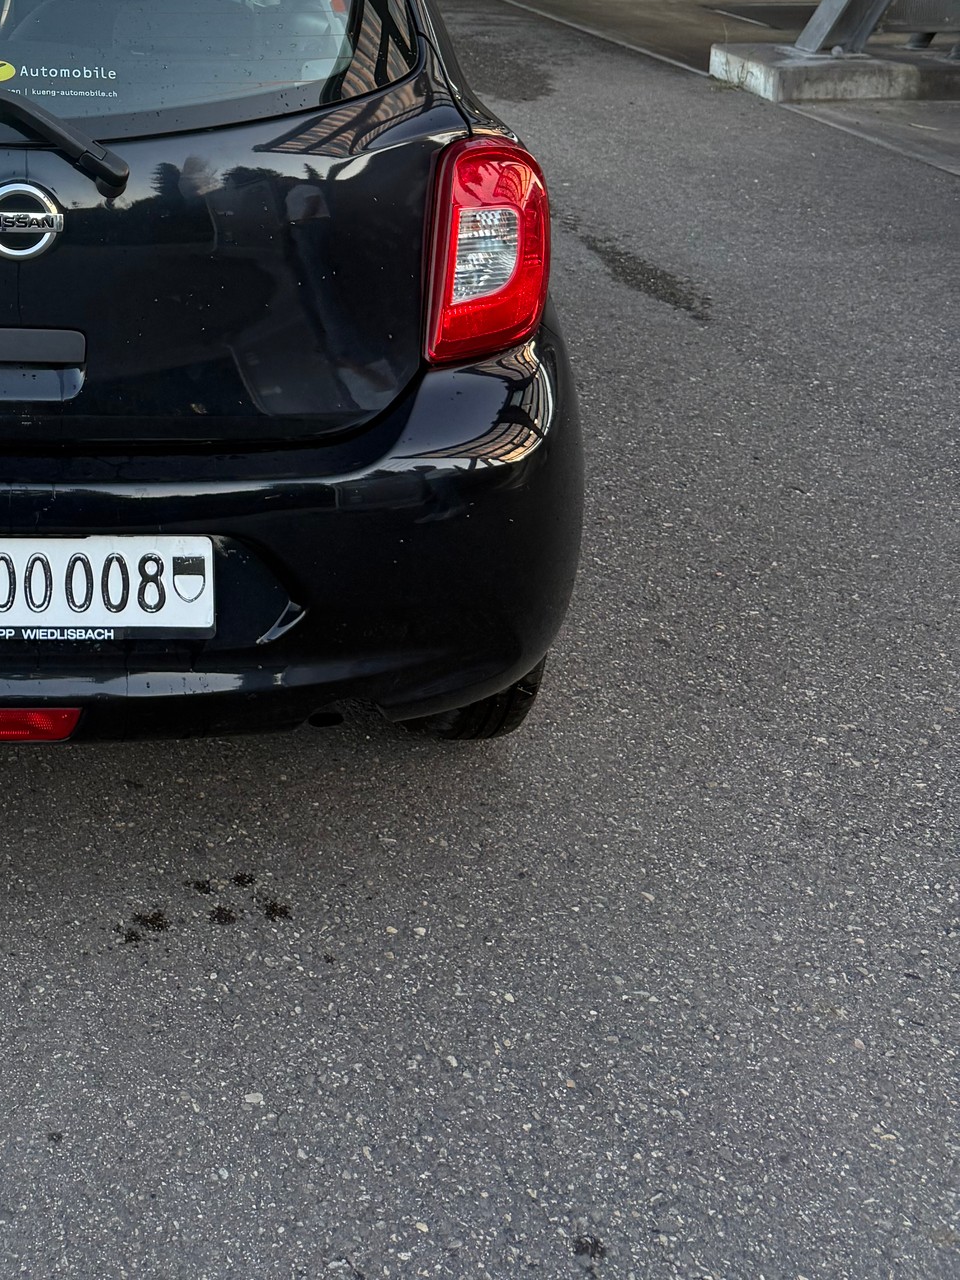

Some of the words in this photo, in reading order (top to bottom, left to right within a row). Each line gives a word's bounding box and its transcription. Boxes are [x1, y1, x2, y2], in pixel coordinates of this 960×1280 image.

[19, 65, 118, 80] Automobile
[31, 88, 118, 98] kueng-automobile.ch
[21, 628, 115, 640] WIEDLISBACH
